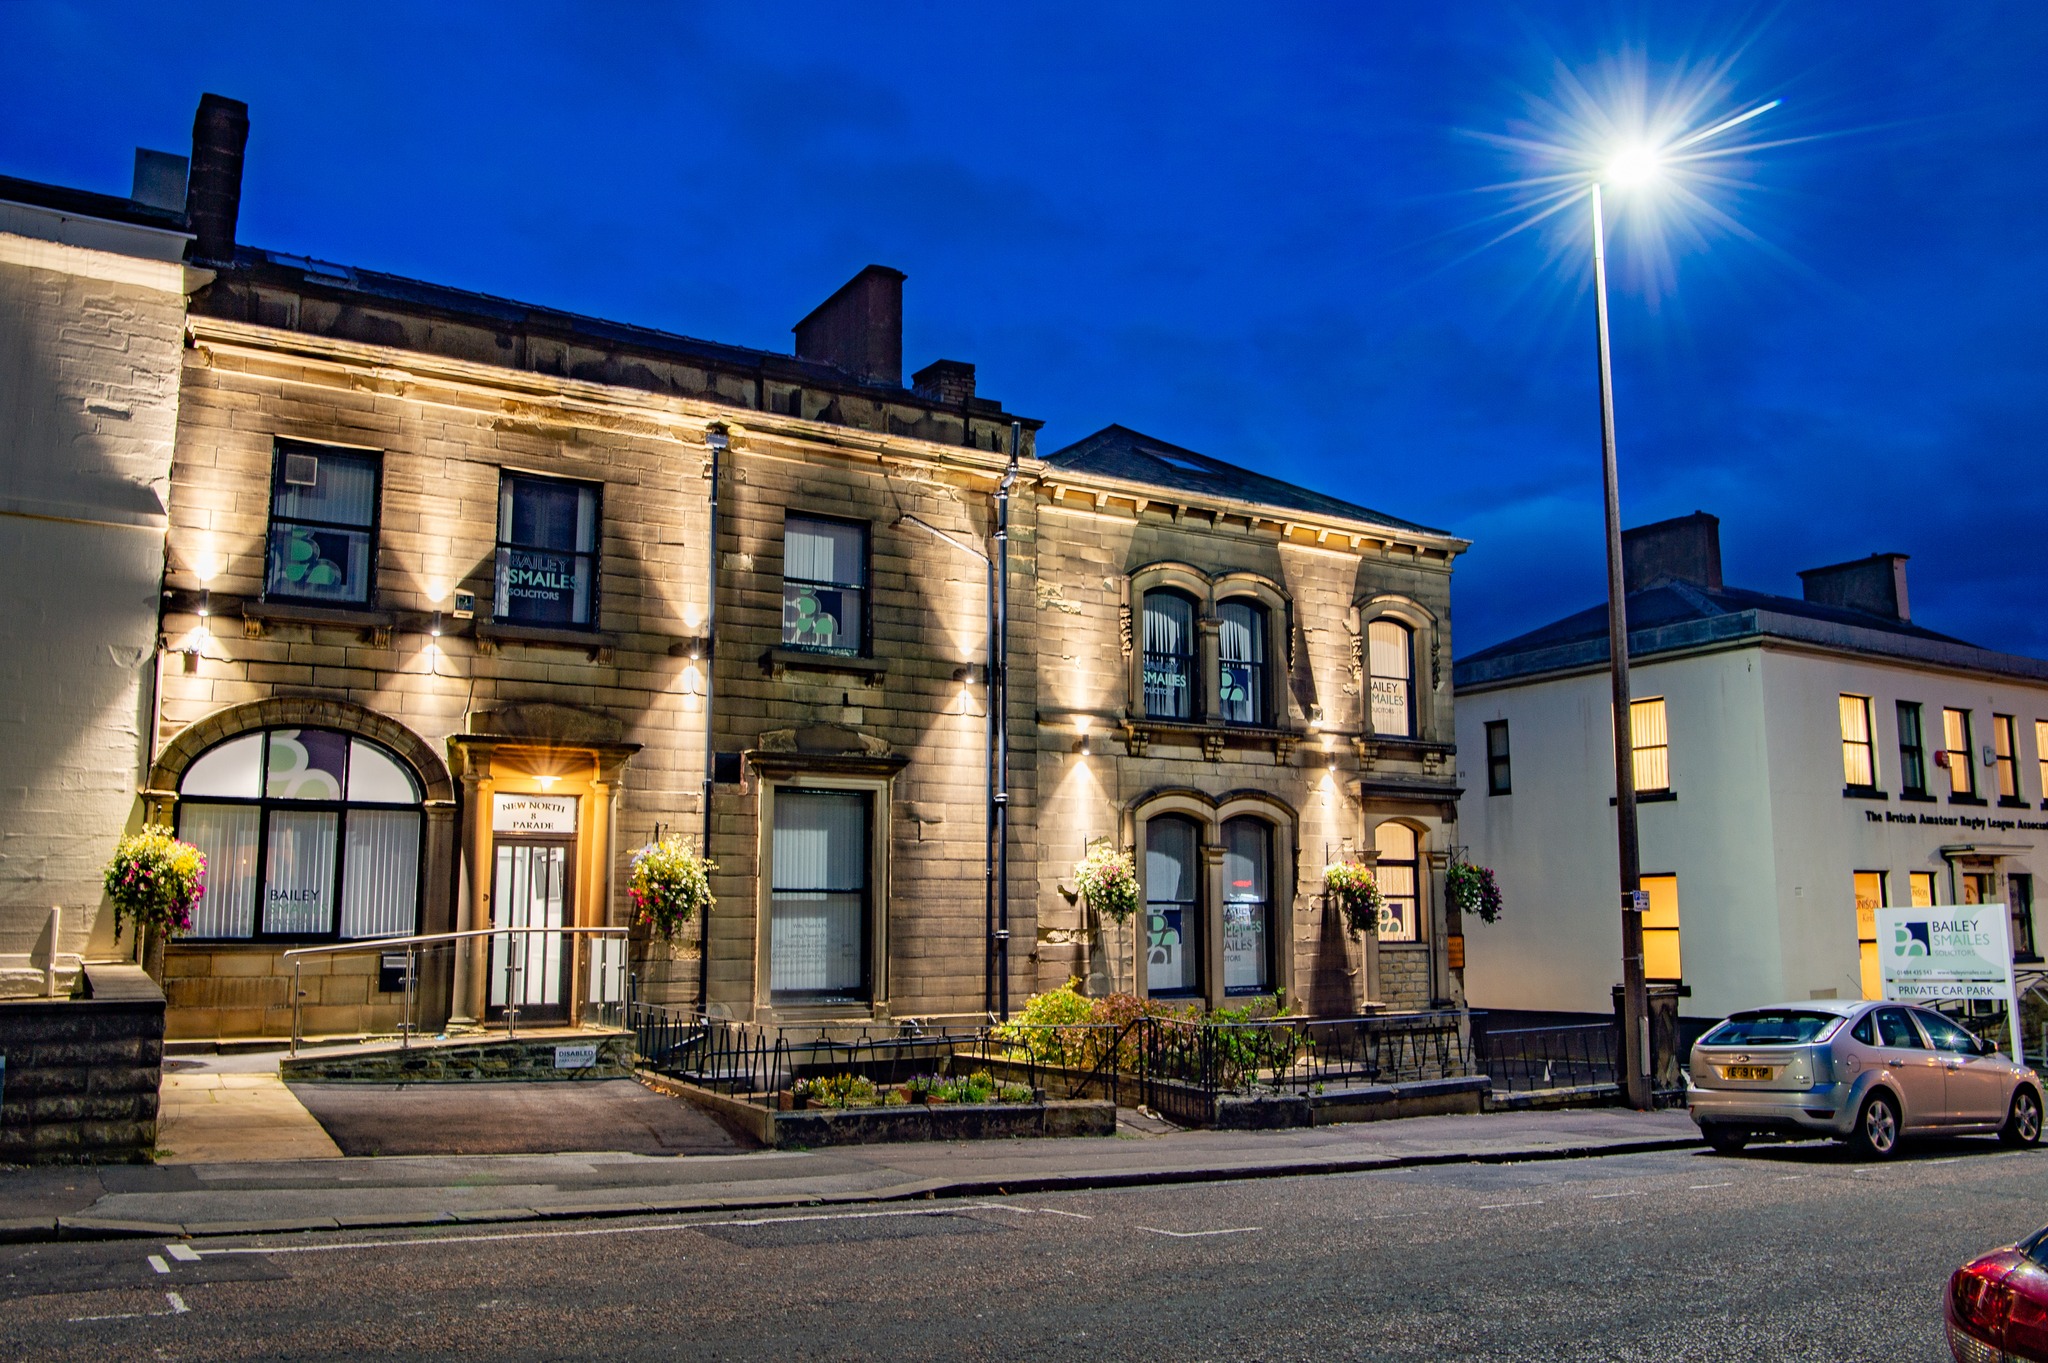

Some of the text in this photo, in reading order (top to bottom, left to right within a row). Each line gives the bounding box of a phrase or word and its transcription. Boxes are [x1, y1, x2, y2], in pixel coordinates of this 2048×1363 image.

[511, 554, 569, 573] BAILEY
[509, 568, 578, 590] SMAILES
[508, 587, 560, 601] SOLICITORS
[1143, 670, 1187, 687] SMAILES
[1144, 686, 1175, 696] OLICITORS
[1371, 681, 1398, 693] AILEY
[1371, 693, 1404, 706] MAILES
[502, 801, 566, 813] NEW NORTH
[512, 821, 554, 830] PARADE
[1865, 810, 1883, 823] The
[1886, 811, 1917, 824] British
[1919, 813, 1958, 826] Amateur
[1960, 816, 1986, 830] Rugby
[1987, 818, 2015, 831] League
[270, 889, 320, 901] BAILEY
[1223, 920, 1262, 934] MAILES
[1932, 920, 1979, 932] BAILEY
[1933, 933, 1990, 946] SMAILES
[1934, 949, 1976, 957] SOLICITORS
[1898, 986, 1995, 995] PRIVATE CAR PARK
